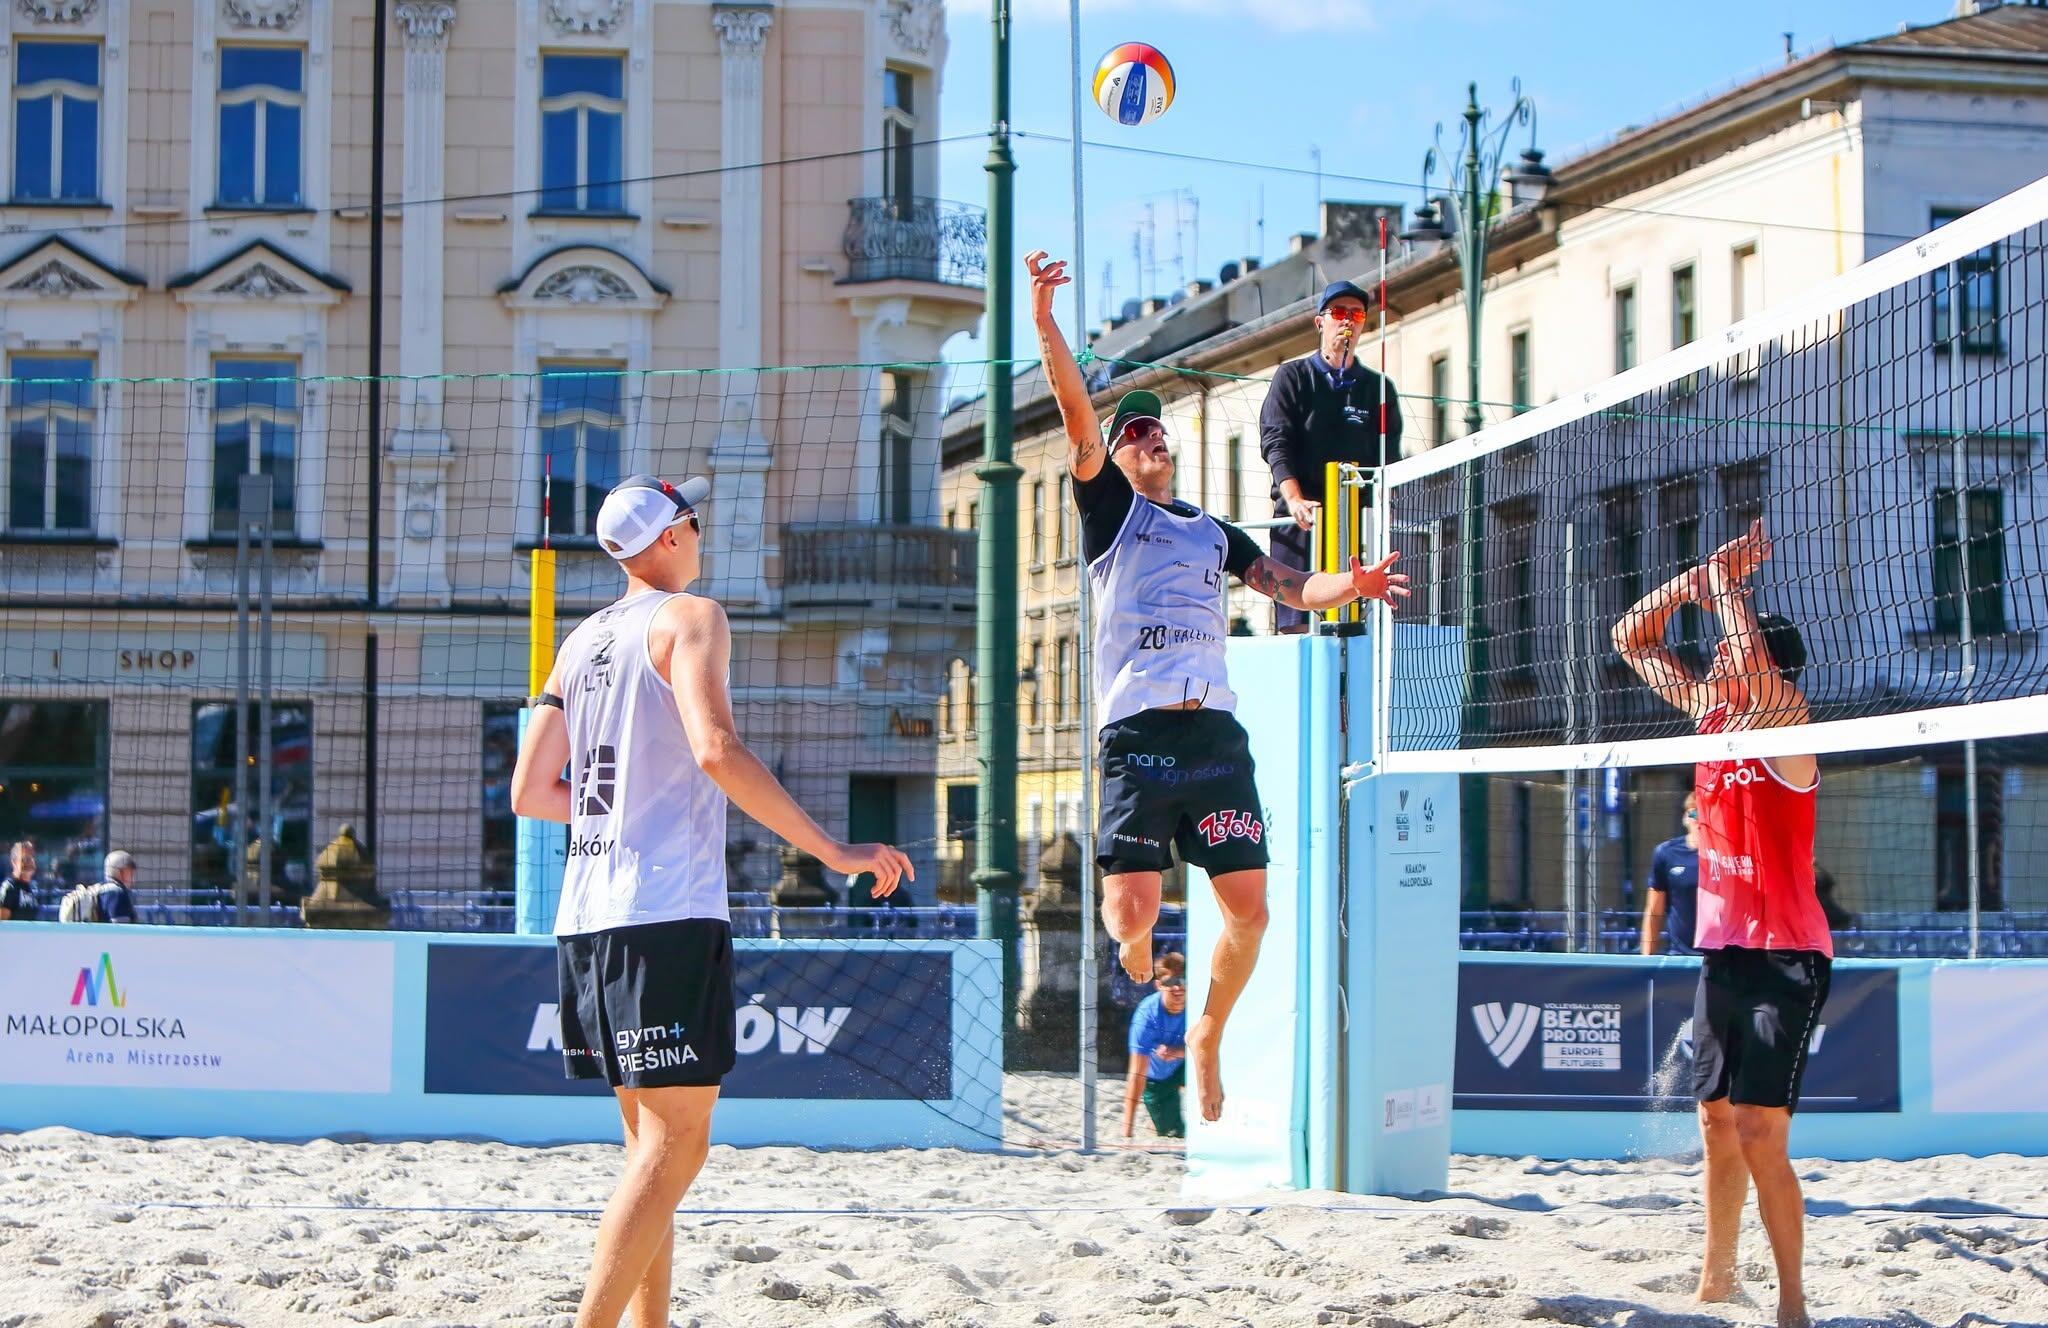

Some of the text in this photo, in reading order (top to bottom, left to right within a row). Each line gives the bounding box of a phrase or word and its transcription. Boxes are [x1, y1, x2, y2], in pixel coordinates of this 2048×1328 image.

[1139, 624, 1167, 650] 20
[120, 649, 196, 671] SHOP
[584, 669, 616, 692] LTU
[1127, 753, 1176, 767] nano
[1722, 766, 1765, 790] POL
[6, 1014, 187, 1039] MAŁOPOLSKA
[1543, 1010, 1621, 1029] BEACH
[1543, 1029, 1621, 1042] PRO TOUR
[66, 1047, 222, 1067] Arena Mistrzostw
[618, 1044, 699, 1073] PIEŠINA
[1560, 1047, 1605, 1056] EUROPE
[1560, 1059, 1604, 1067] FUTURES
